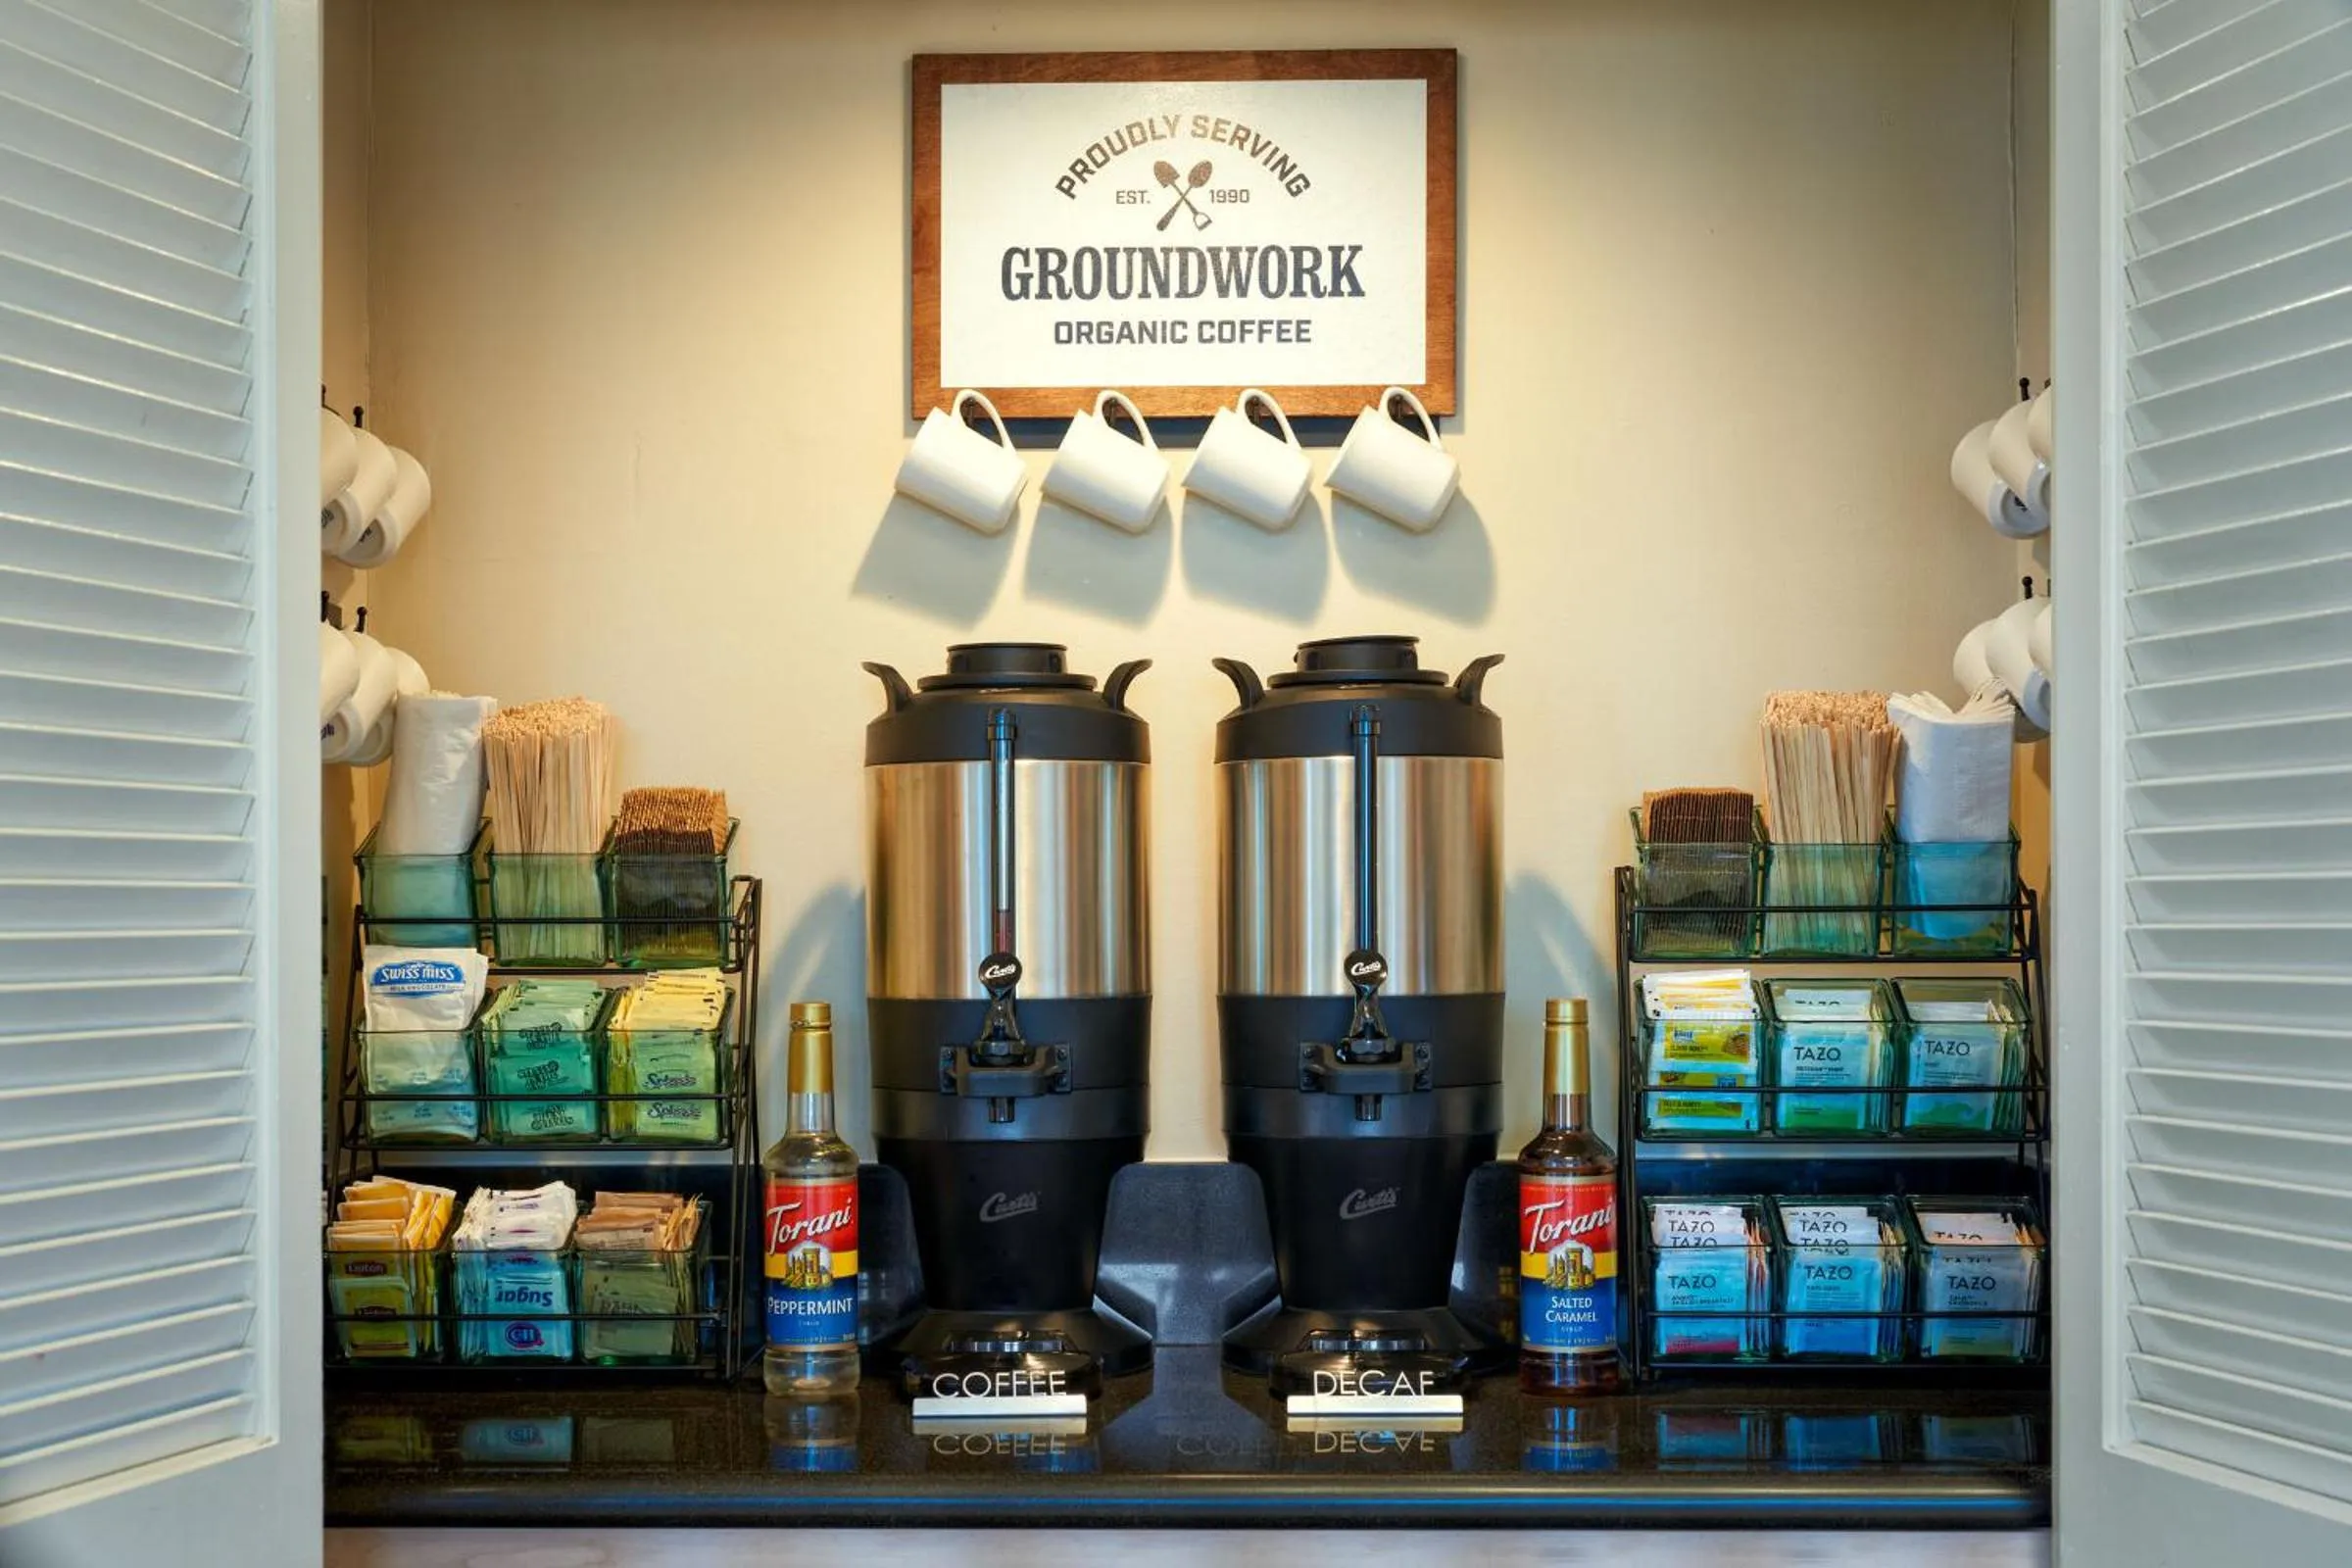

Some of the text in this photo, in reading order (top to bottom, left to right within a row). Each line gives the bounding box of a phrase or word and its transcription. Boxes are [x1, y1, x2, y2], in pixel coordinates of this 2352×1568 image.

[1054, 114, 1311, 200] PROUDLY SERVING
[1115, 189, 1250, 205] EST. 1990
[1001, 244, 1366, 301] GROUNDWORK
[1054, 319, 1312, 345] ORGANIC COFFEE
[1793, 1047, 1842, 1061] TAZO
[1924, 1041, 1971, 1056] TAZO
[765, 1196, 853, 1256] Torani
[1524, 1195, 1616, 1255] Torani
[1668, 1220, 1715, 1233] TAZO
[1800, 1219, 1848, 1233] TAZO
[1803, 1265, 1853, 1280] TAZO
[1667, 1275, 1718, 1290] TAZO
[1946, 1276, 1996, 1291] TAZO
[495, 1286, 554, 1307] Sugar
[1550, 1295, 1592, 1309] SALTED
[766, 1297, 854, 1316] PEPPERMINT
[1544, 1308, 1597, 1323] CARAMEL
[932, 1370, 1067, 1397] COFFEE
[1313, 1369, 1435, 1396] DECAF
